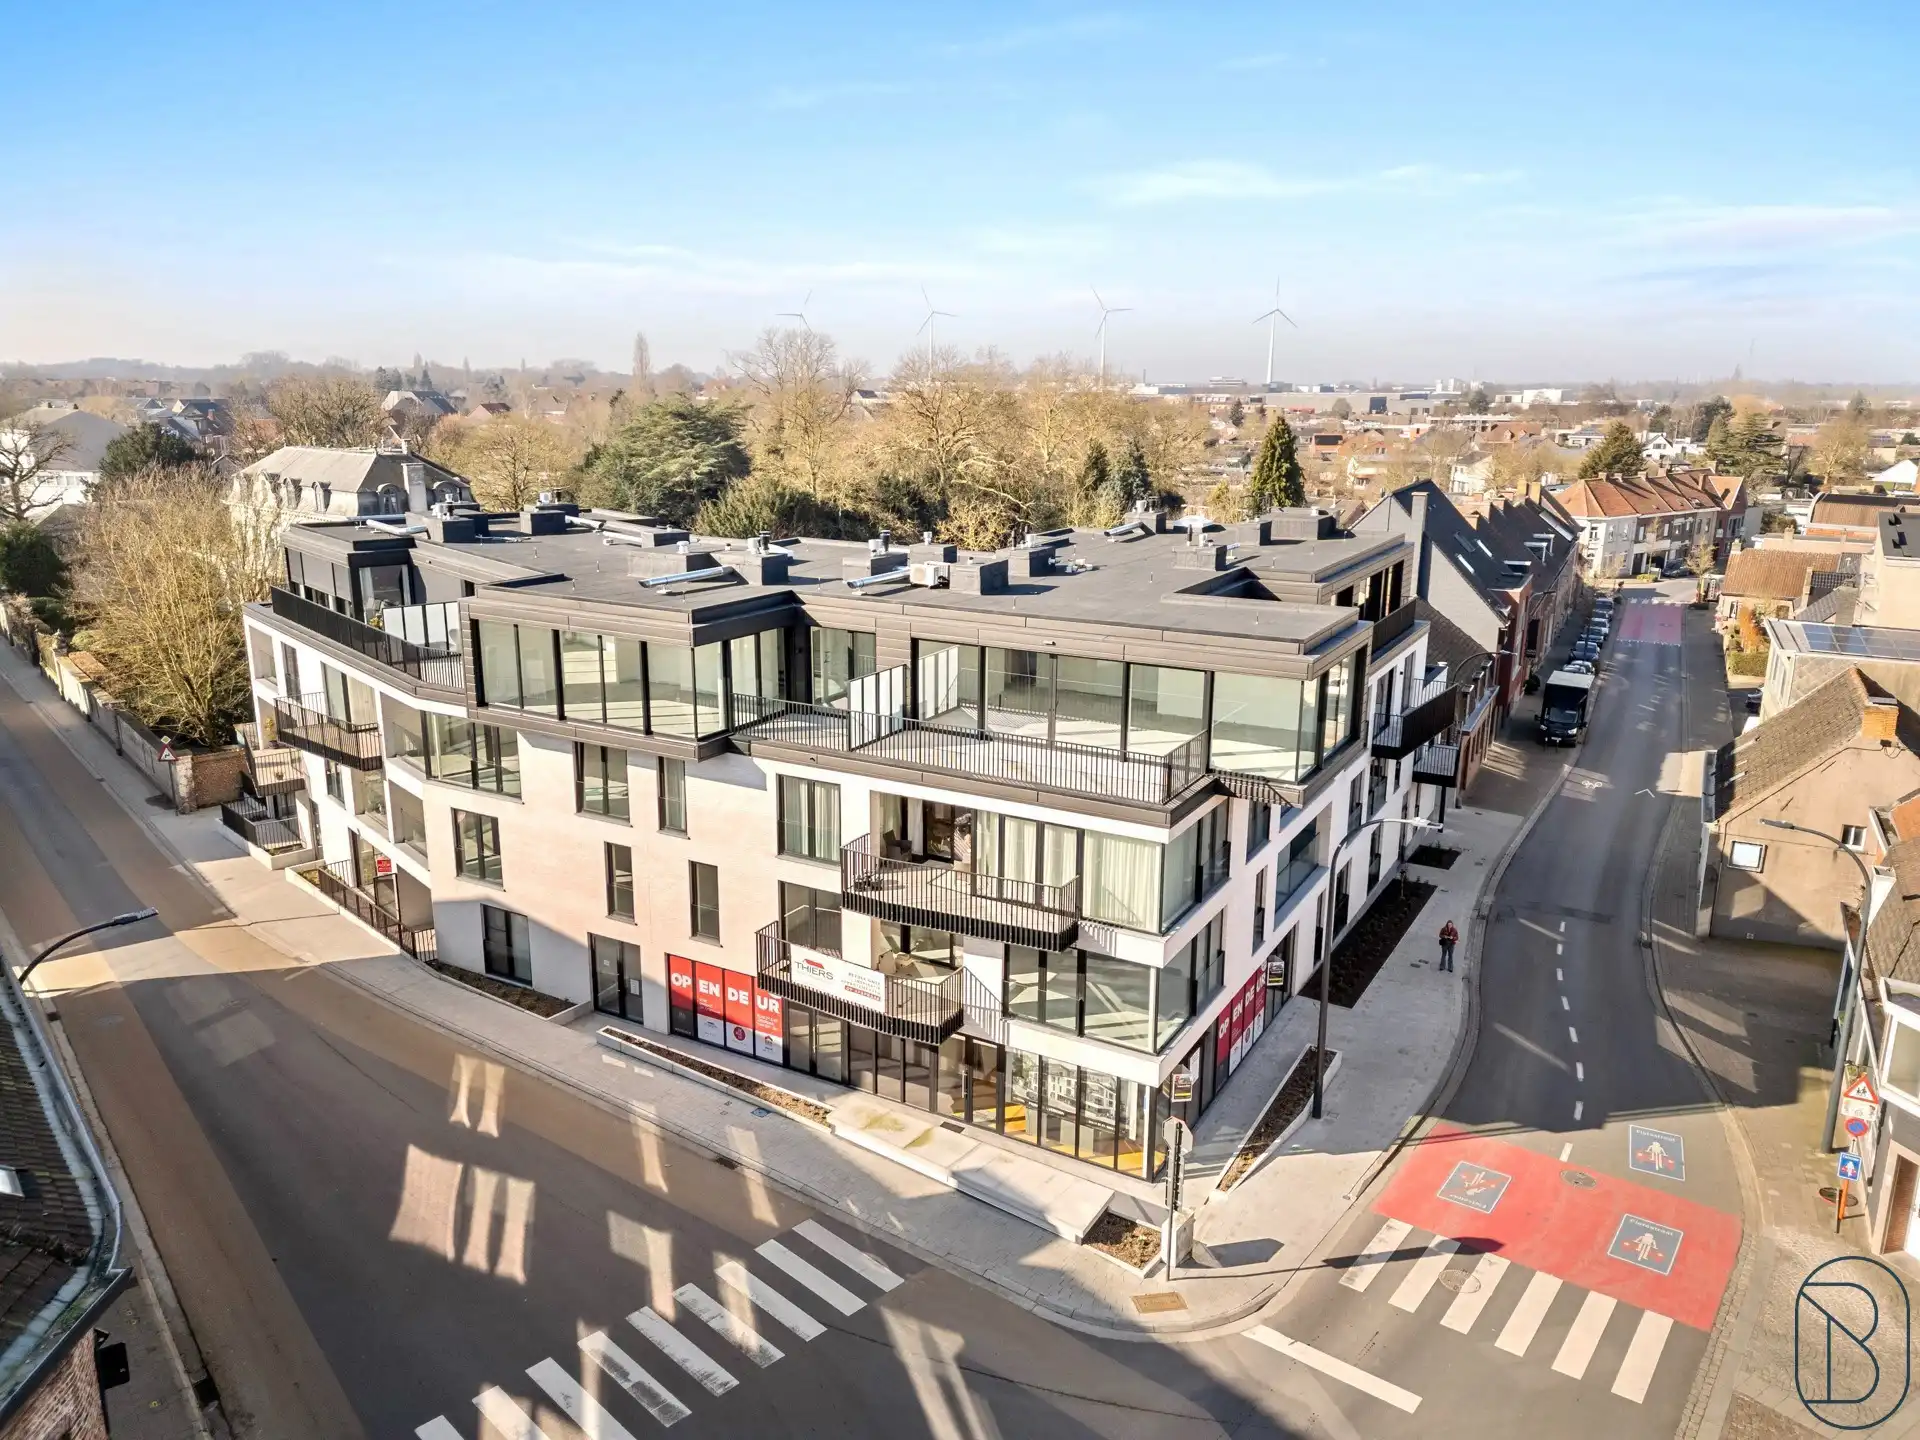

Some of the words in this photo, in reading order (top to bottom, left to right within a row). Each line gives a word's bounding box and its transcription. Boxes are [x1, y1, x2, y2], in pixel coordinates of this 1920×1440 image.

[794, 960, 834, 980] THIERS
[671, 972, 692, 988] OP
[699, 979, 720, 997] EN
[727, 987, 749, 1006] DE
[756, 994, 780, 1014] UR
[1219, 1016, 1230, 1039] OP
[1232, 999, 1243, 1023] EN
[1245, 985, 1255, 1008] DE
